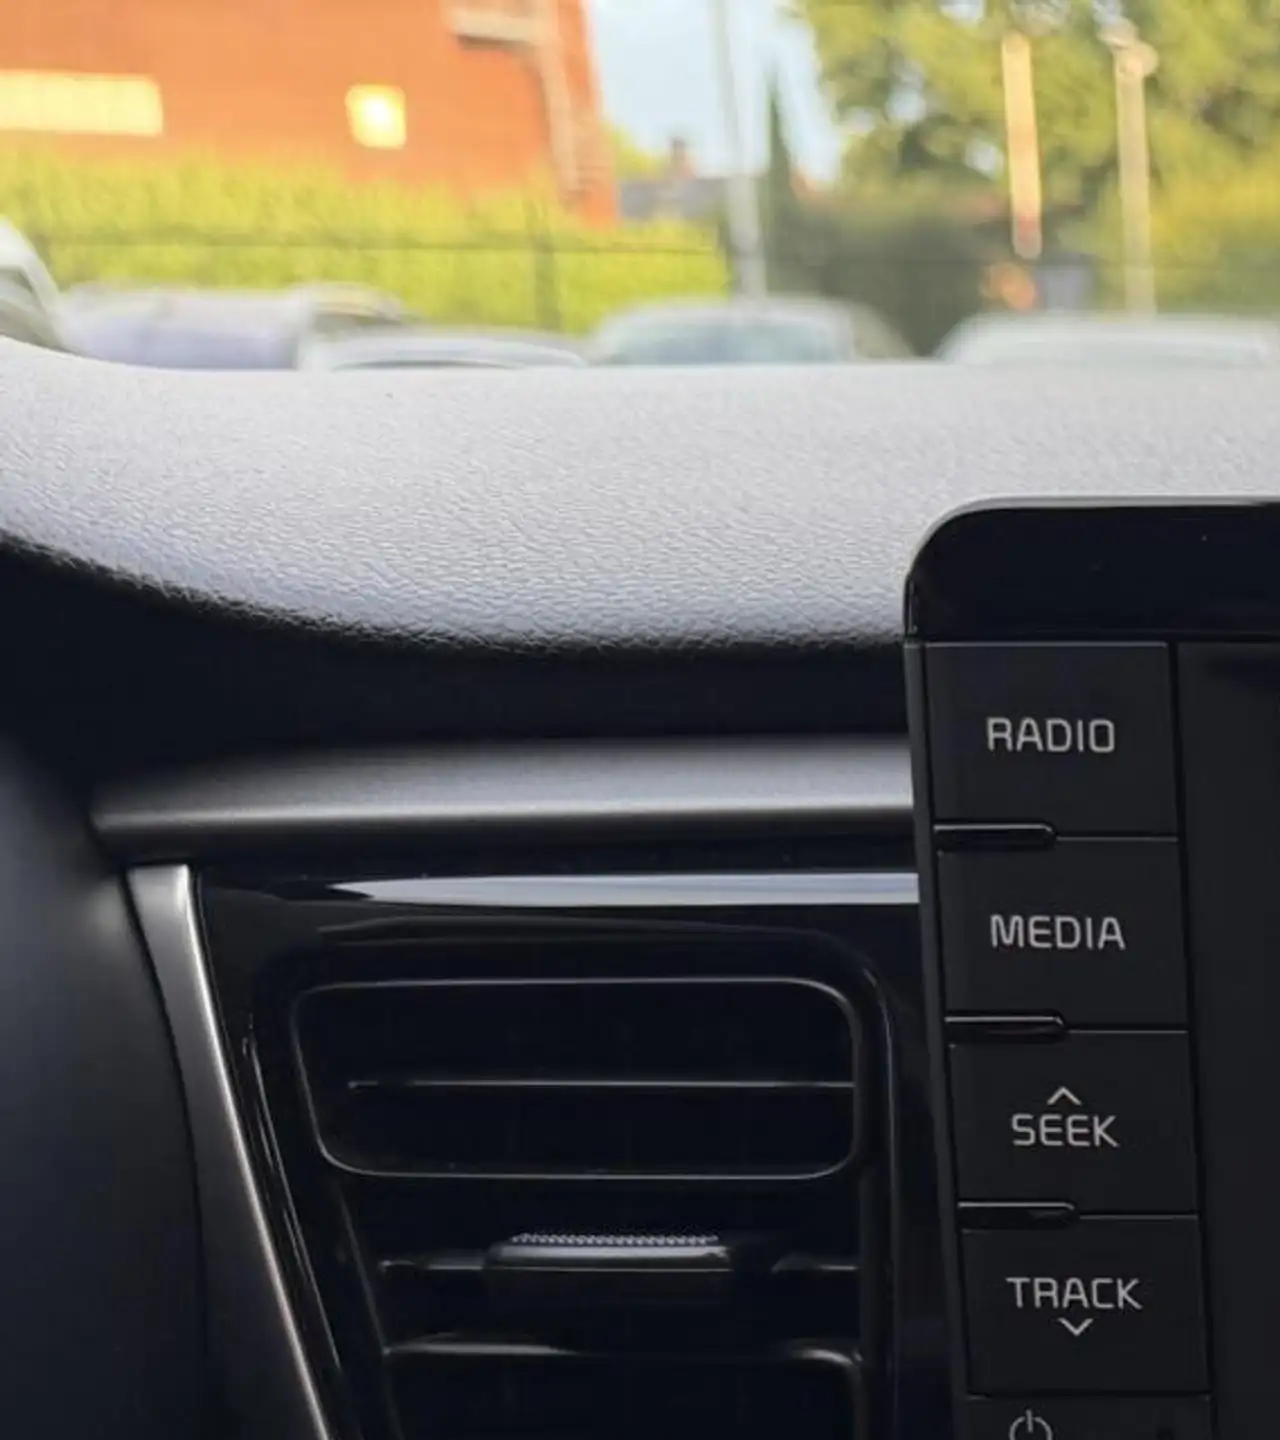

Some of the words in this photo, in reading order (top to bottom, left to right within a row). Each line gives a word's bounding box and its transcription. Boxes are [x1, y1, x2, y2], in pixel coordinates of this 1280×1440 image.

[985, 716, 1117, 753] RADIO
[989, 914, 1126, 951] MEDIA
[1012, 1114, 1119, 1147] SEEK
[1006, 1277, 1142, 1311] TRACK
